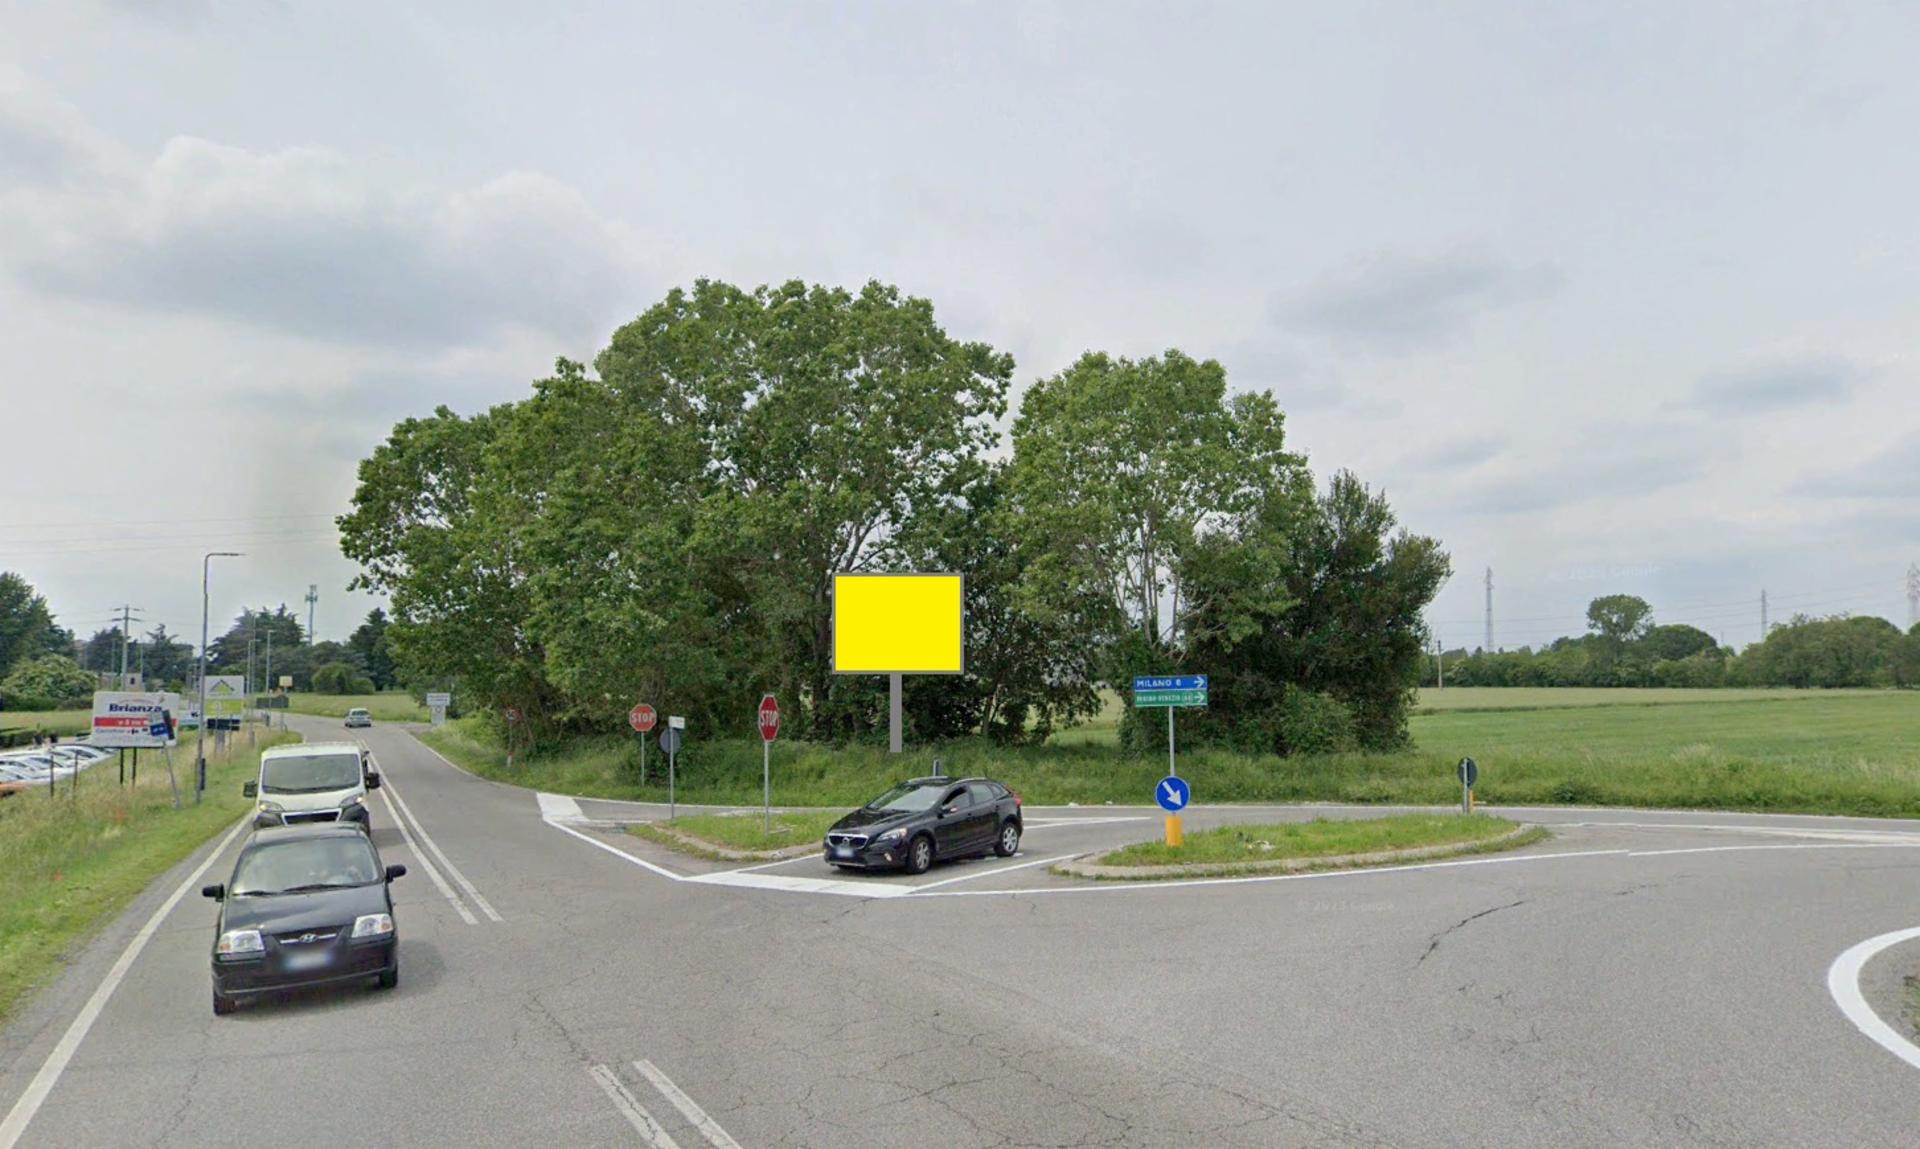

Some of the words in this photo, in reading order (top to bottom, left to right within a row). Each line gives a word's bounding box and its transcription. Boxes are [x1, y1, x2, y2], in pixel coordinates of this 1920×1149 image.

[1136, 679, 1172, 688] MILANO
[109, 703, 162, 713] Brianza
[631, 712, 656, 723] STOP
[760, 709, 779, 727] STOP
